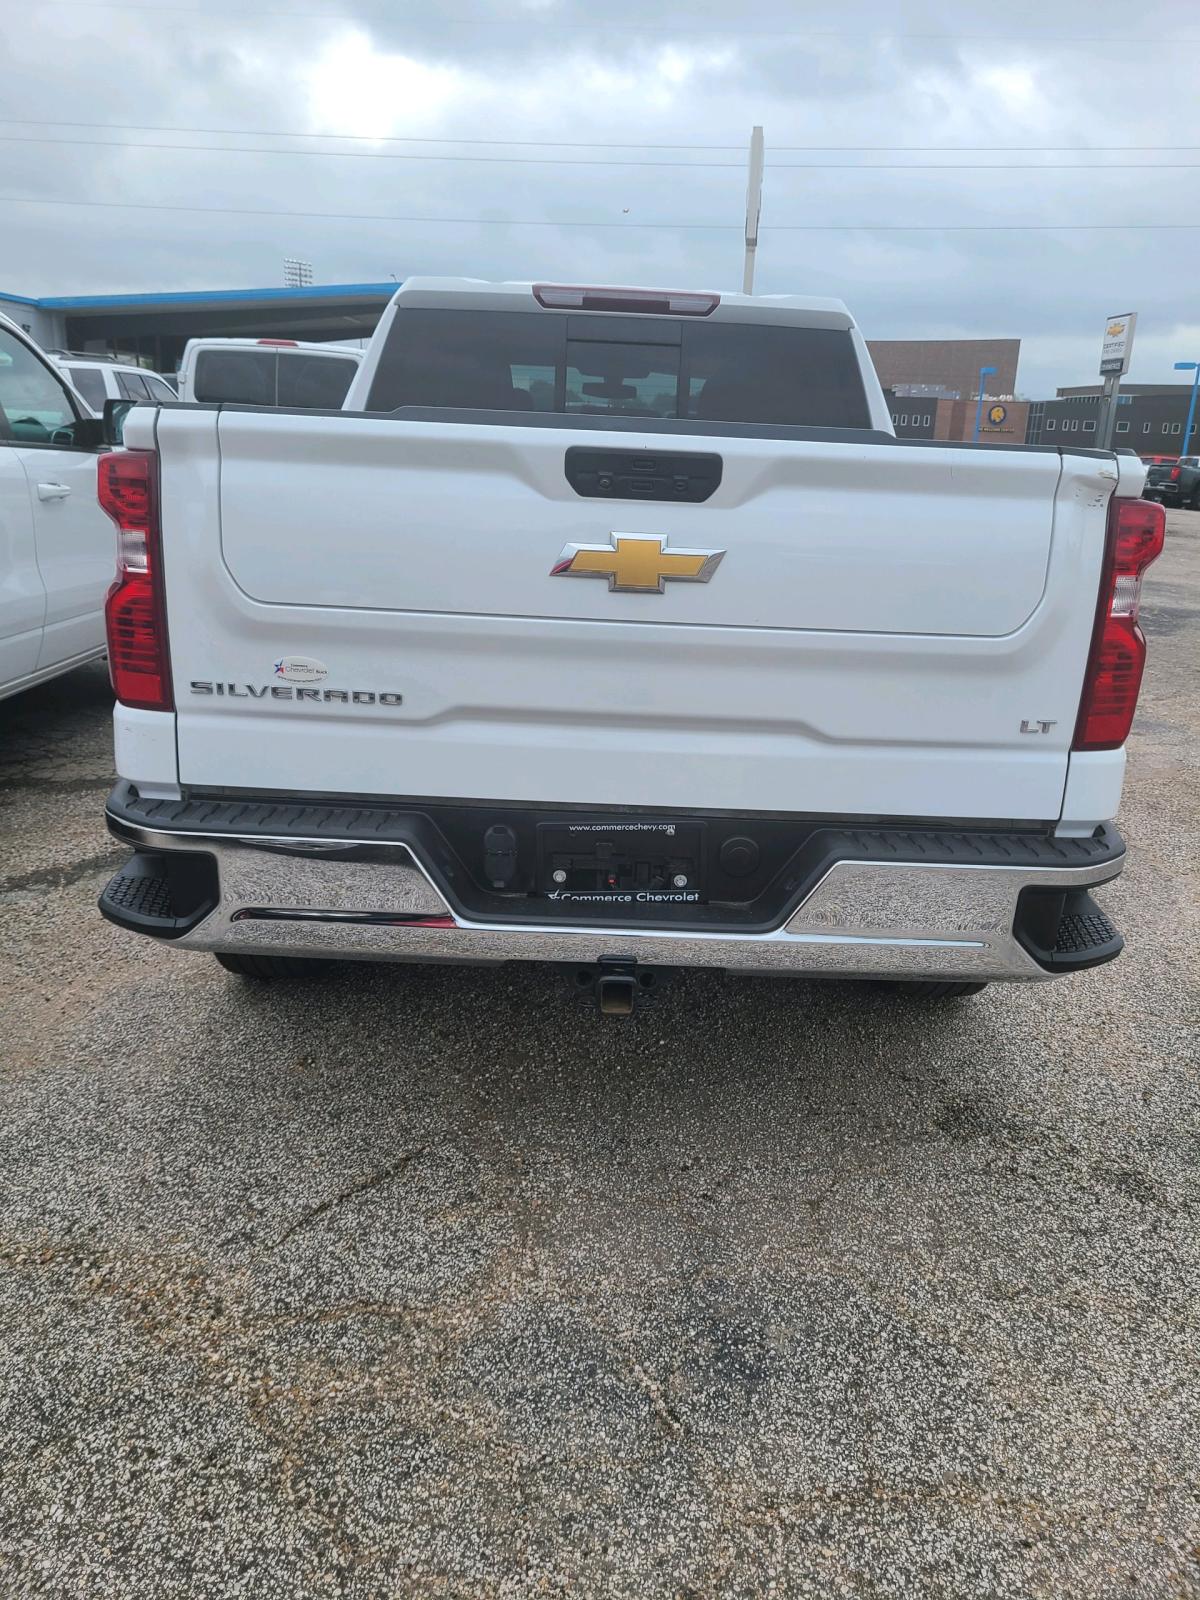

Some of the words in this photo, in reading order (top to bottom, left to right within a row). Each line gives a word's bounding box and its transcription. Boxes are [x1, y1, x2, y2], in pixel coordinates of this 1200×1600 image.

[190, 681, 403, 706] SILVERADO
[1020, 719, 1058, 734] LT
[569, 823, 676, 832] www.commercechevy.com
[636, 892, 699, 902] Chevrolet
